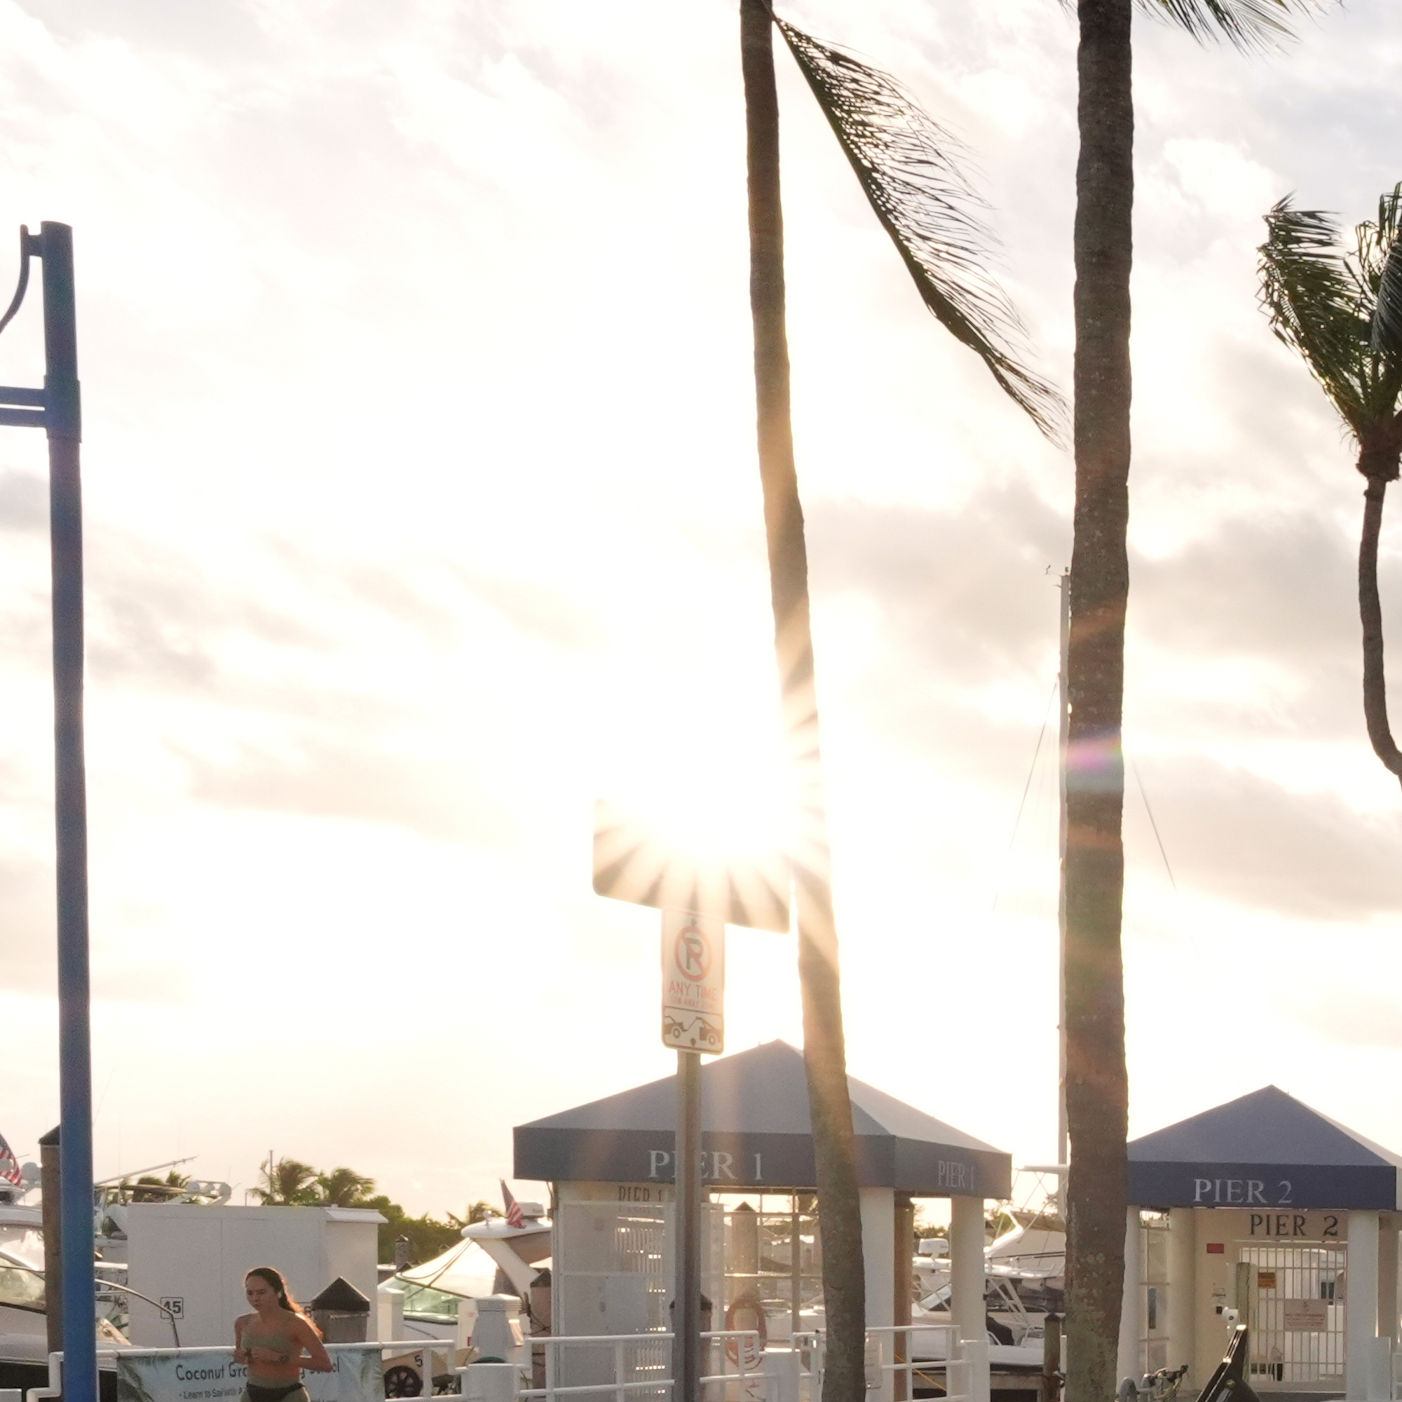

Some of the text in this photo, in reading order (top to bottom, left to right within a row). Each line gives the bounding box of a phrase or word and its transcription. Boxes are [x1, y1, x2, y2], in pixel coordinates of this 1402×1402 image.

[669, 980, 691, 996] ANY
[754, 1153, 764, 1180] 1
[937, 1160, 966, 1190] PIER
[1193, 1178, 1293, 1204] PIER 2
[1249, 1214, 1339, 1236] PIER 2
[164, 1300, 182, 1314] 45
[175, 1361, 248, 1381] Coconut Gro
